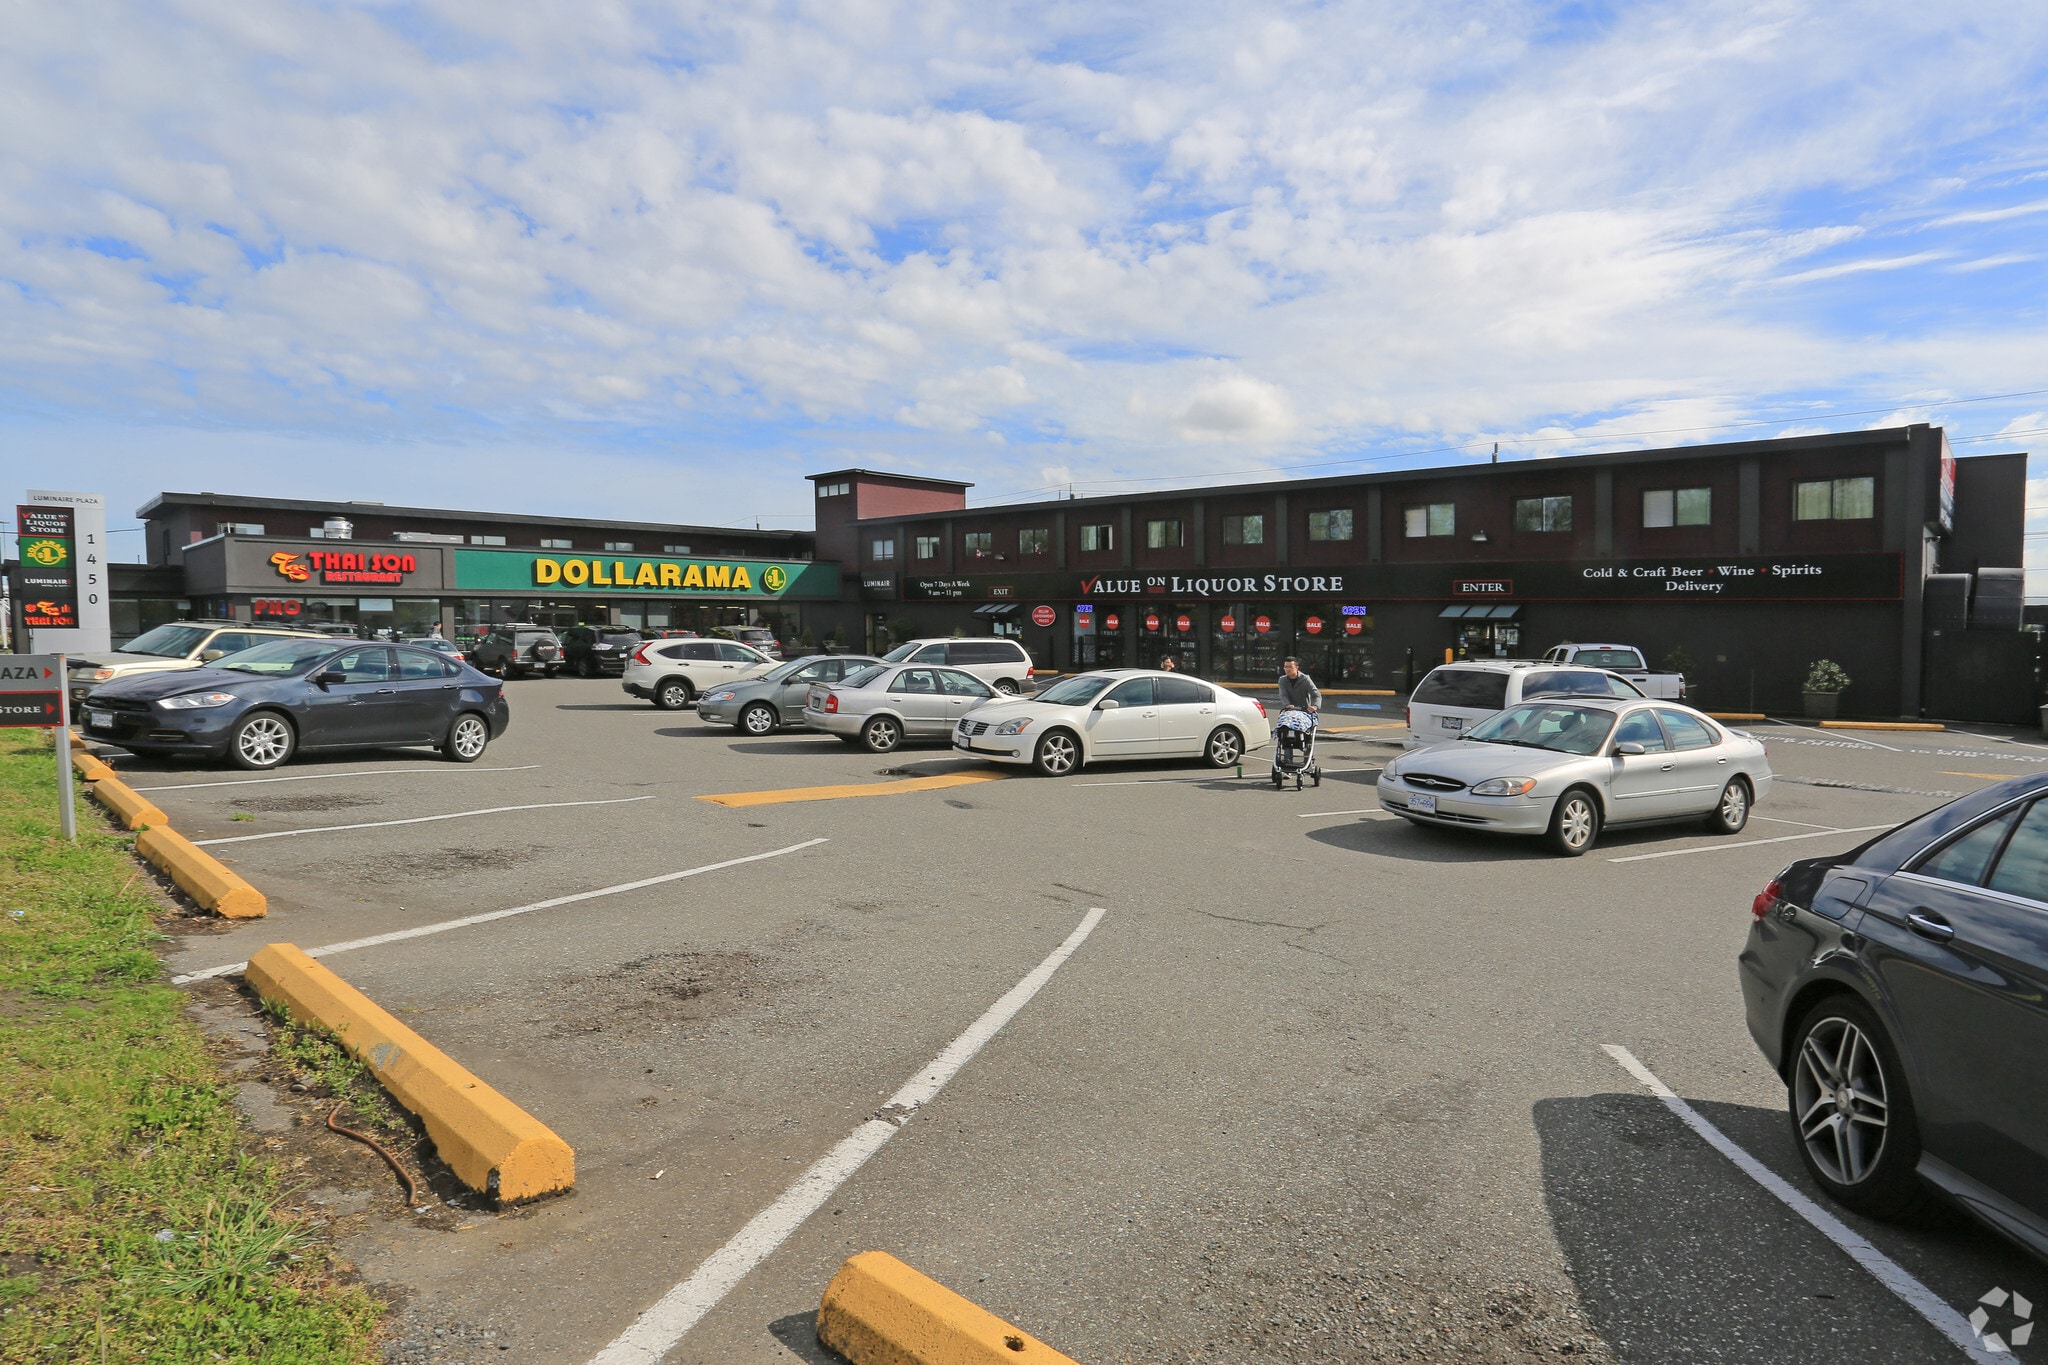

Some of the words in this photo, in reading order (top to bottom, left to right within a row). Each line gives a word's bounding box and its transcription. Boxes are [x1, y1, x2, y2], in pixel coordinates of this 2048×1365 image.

[33, 495, 74, 503] LUMINAIRE
[26, 519, 67, 527] LIQUOR
[308, 552, 365, 570] THAI
[370, 553, 416, 572] SON
[324, 570, 403, 582] RESTAURANT
[536, 558, 751, 588] DOLLARAMA
[1583, 568, 1613, 578] Cold
[1618, 568, 1628, 578] &
[1633, 566, 1667, 577] Craft
[1671, 566, 1704, 577] Beer
[1717, 565, 1755, 576] Wine
[1772, 564, 1822, 578] Spirits
[1146, 576, 1166, 586] ON
[1171, 576, 1258, 596] LIQUOR
[1264, 574, 1343, 592] STORE
[1462, 583, 1504, 592] ENTER
[1666, 580, 1724, 594] Delivery
[254, 599, 302, 616] PHO
[1342, 606, 1366, 616] OPEN
[24, 616, 51, 625] THAI
